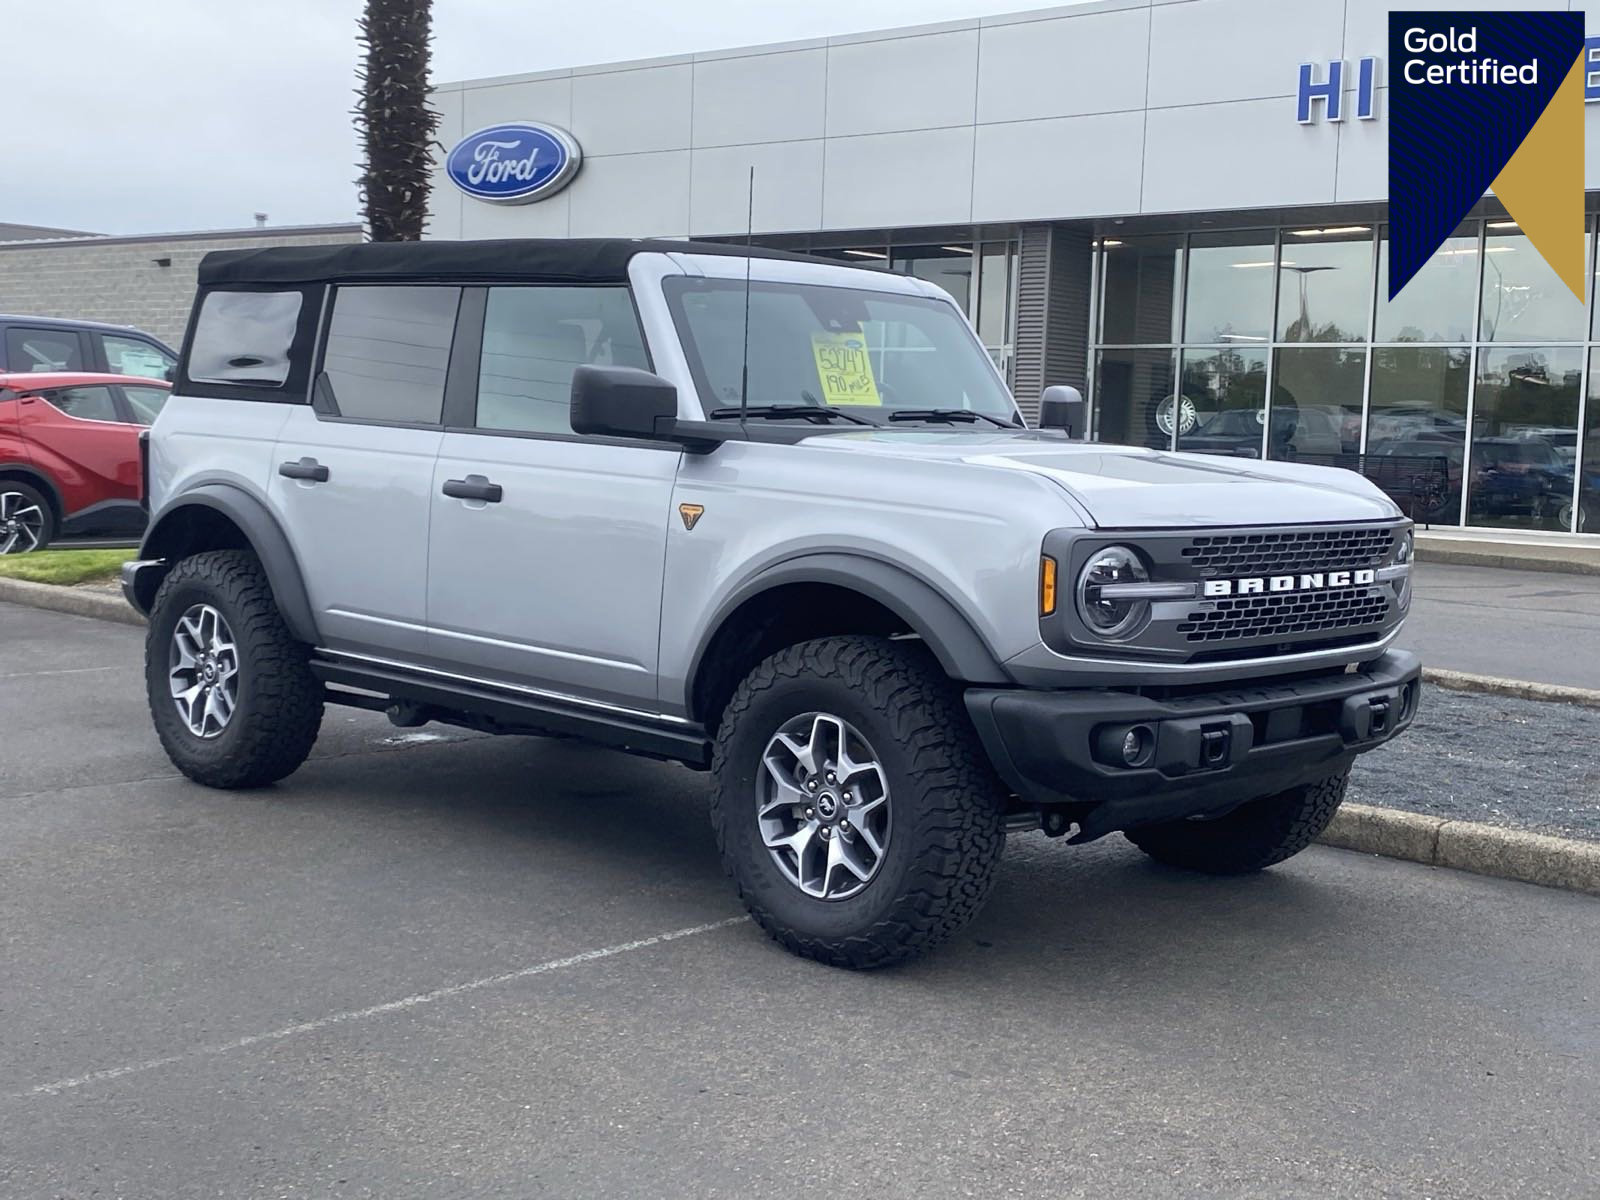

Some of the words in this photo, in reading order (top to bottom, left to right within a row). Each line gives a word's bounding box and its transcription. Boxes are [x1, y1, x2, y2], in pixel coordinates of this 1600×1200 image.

[467, 140, 540, 186] Ford
[825, 374, 847, 393] 190
[1203, 568, 1376, 597] BRONCO
